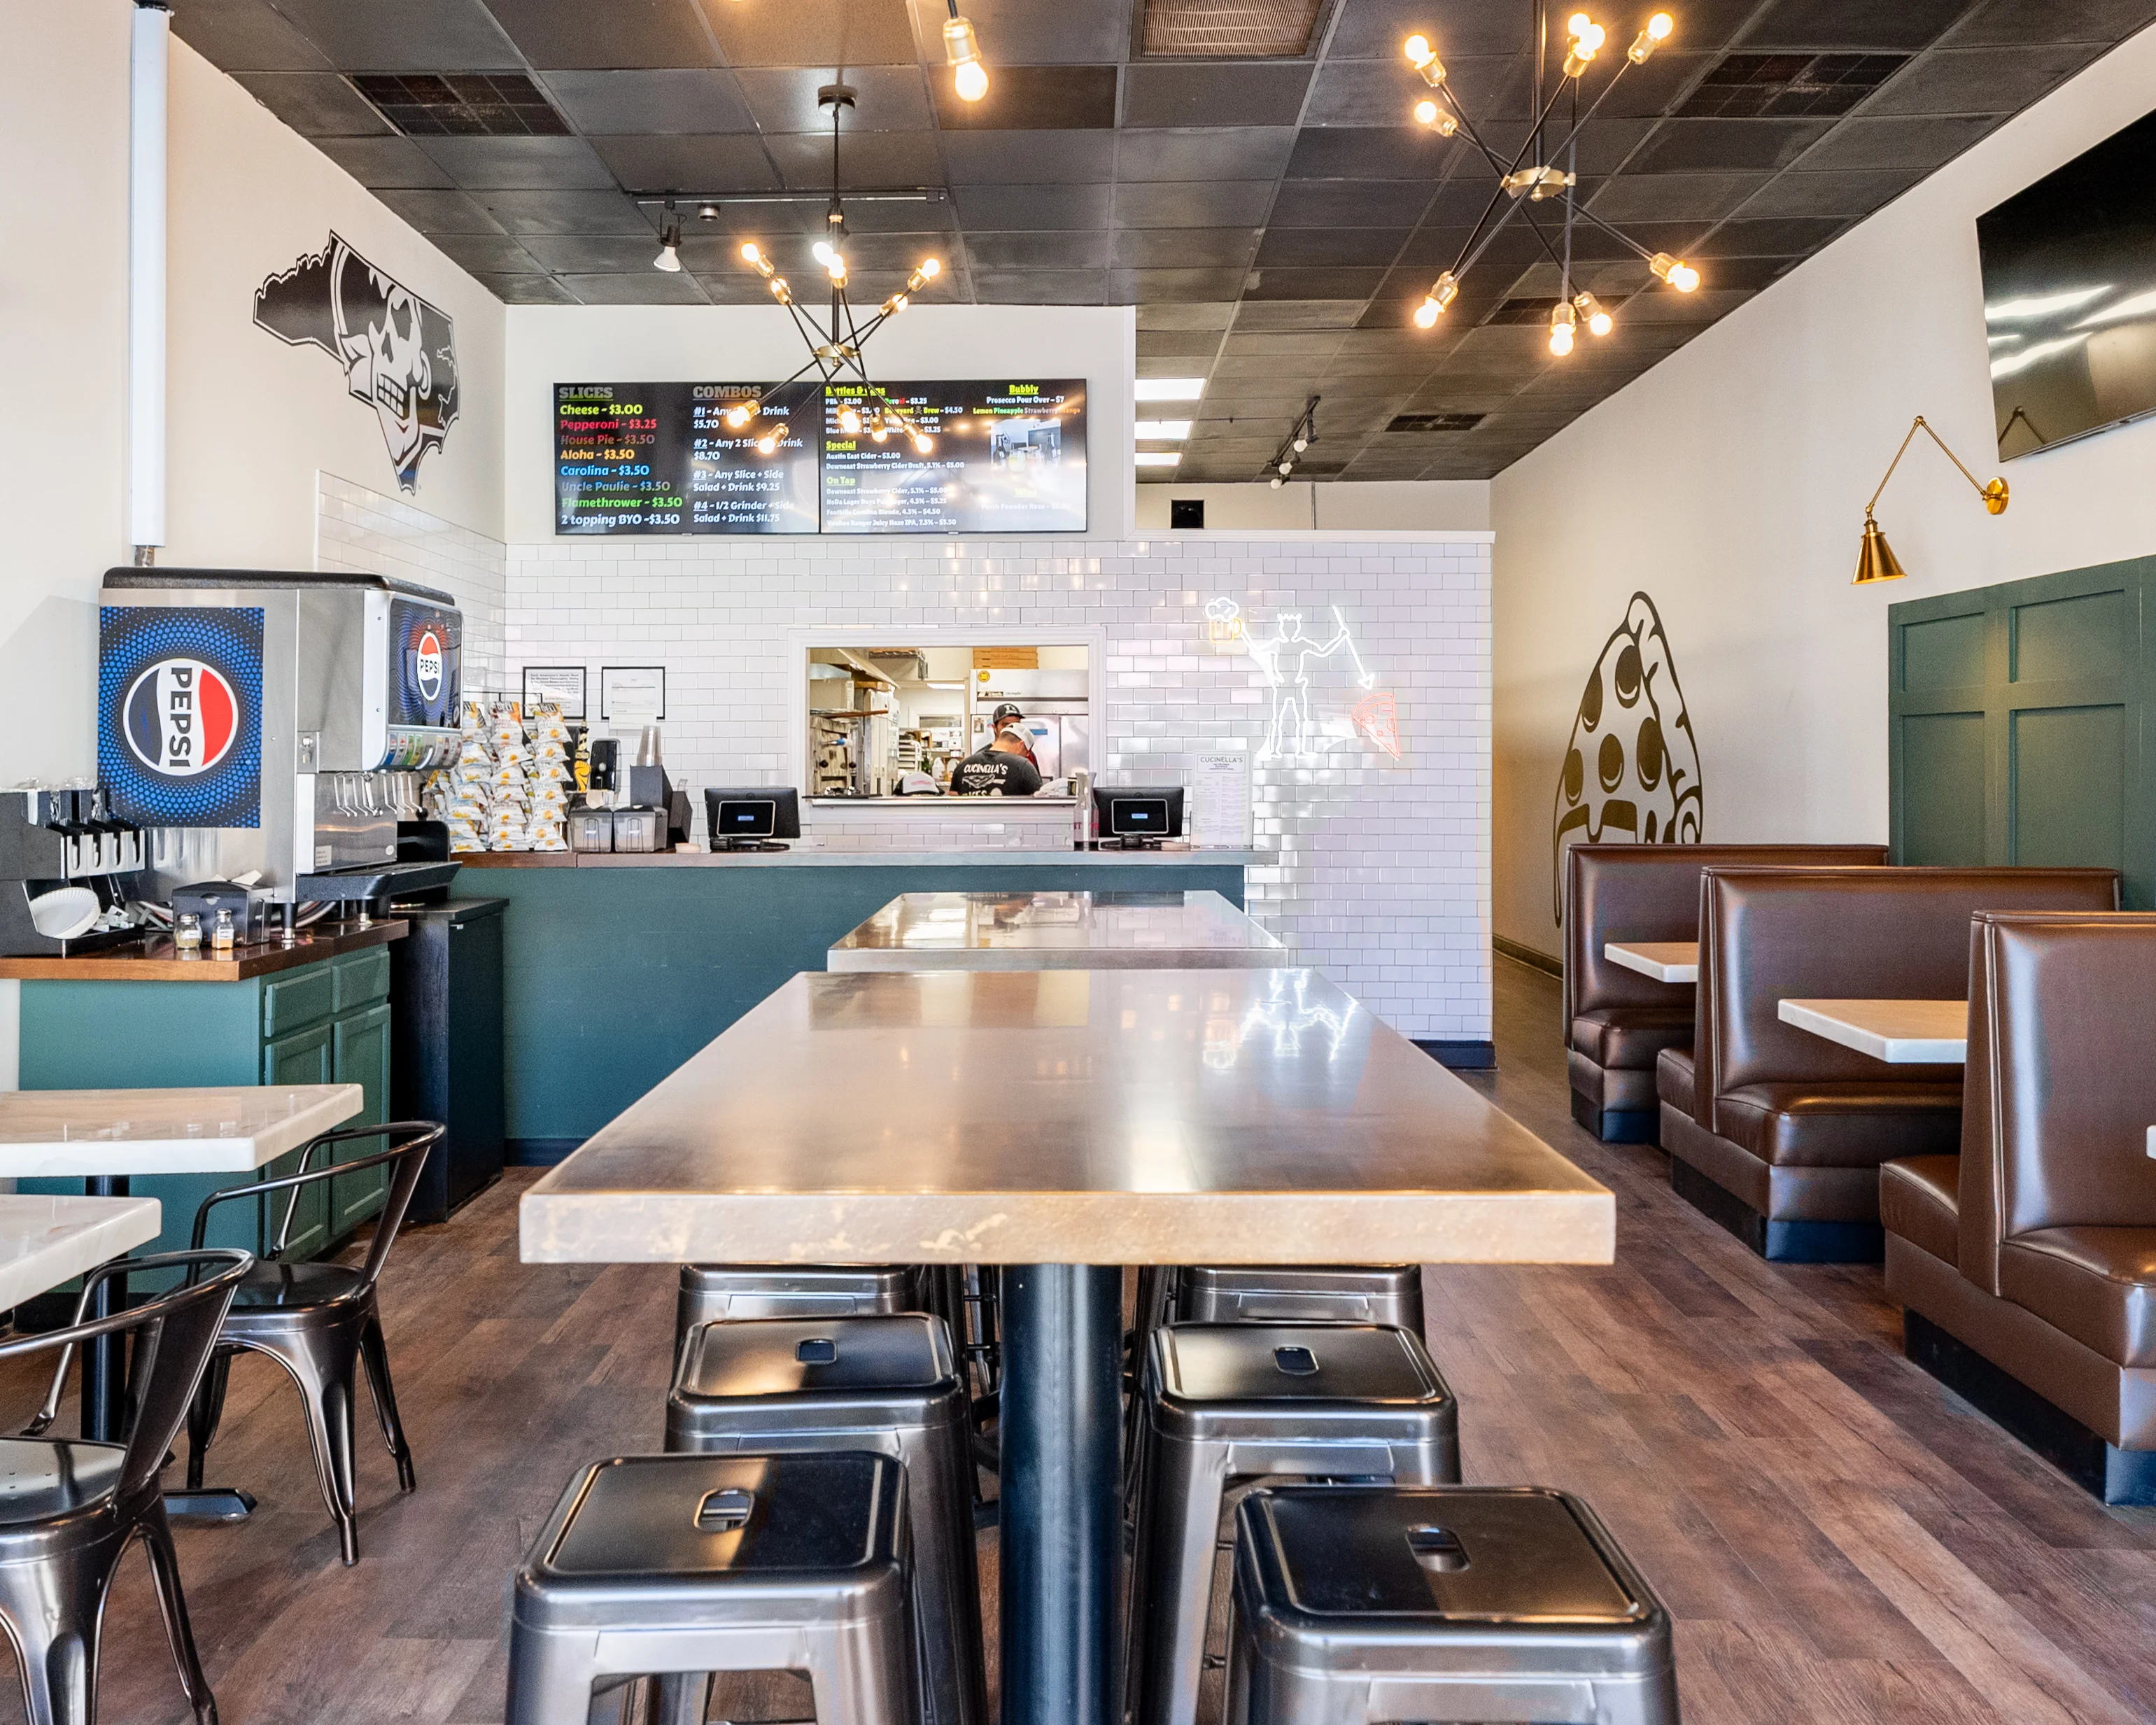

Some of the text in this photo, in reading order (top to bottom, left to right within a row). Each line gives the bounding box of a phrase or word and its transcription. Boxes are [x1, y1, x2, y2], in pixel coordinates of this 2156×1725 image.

[559, 387, 613, 399] SLICES
[693, 386, 761, 398] COMBOS
[825, 386, 855, 395] Bttles
[1009, 384, 1039, 394] Bubbly
[986, 396, 1015, 404] Prosecco
[1055, 395, 1065, 404] $7
[560, 404, 599, 415] Cheese
[609, 404, 642, 415] $3.00
[693, 407, 705, 416] #1
[763, 407, 789, 416] Drink
[993, 407, 1024, 416] Pineapple
[1024, 407, 1058, 415] Strawberry
[560, 419, 619, 431] Pepperoni
[629, 418, 657, 430] $3.25
[693, 419, 719, 429] $5.70
[561, 435, 594, 445] House
[597, 434, 614, 444] Pie
[624, 434, 655, 445] $3.50
[693, 439, 707, 448] #2
[715, 439, 734, 449] Any
[735, 439, 741, 448] 2
[826, 440, 857, 451] Special
[561, 449, 594, 460] Aloha
[604, 449, 635, 460] $3.50
[693, 451, 720, 461] $8.70
[561, 465, 609, 476] Carolina
[619, 465, 650, 476] $3.50
[693, 470, 707, 479] #3
[714, 470, 733, 481] Any
[734, 470, 756, 479] Slice
[763, 470, 784, 479] Side
[561, 481, 593, 491] Uncle
[595, 480, 630, 491] Paulie
[640, 481, 670, 492] $3.50
[840, 477, 856, 486] Tap
[693, 483, 719, 492] Salad
[728, 483, 754, 492] Drink
[756, 483, 780, 492] $9.25
[561, 497, 642, 507] Flamethrower
[652, 497, 683, 508] $3.50
[693, 501, 707, 510] #4
[716, 501, 728, 510] 1/2
[731, 500, 767, 510] Grinder
[775, 501, 795, 510] Side
[561, 515, 568, 525] 2
[570, 514, 616, 528] topping
[618, 514, 642, 525] BYO
[693, 514, 720, 523] Salad
[728, 514, 755, 523] Drink
[756, 514, 780, 523] $11.75
[420, 659, 440, 675] PEPSI
[169, 667, 192, 767] PEPSI
[964, 763, 1008, 775] CUCINELLA'S
